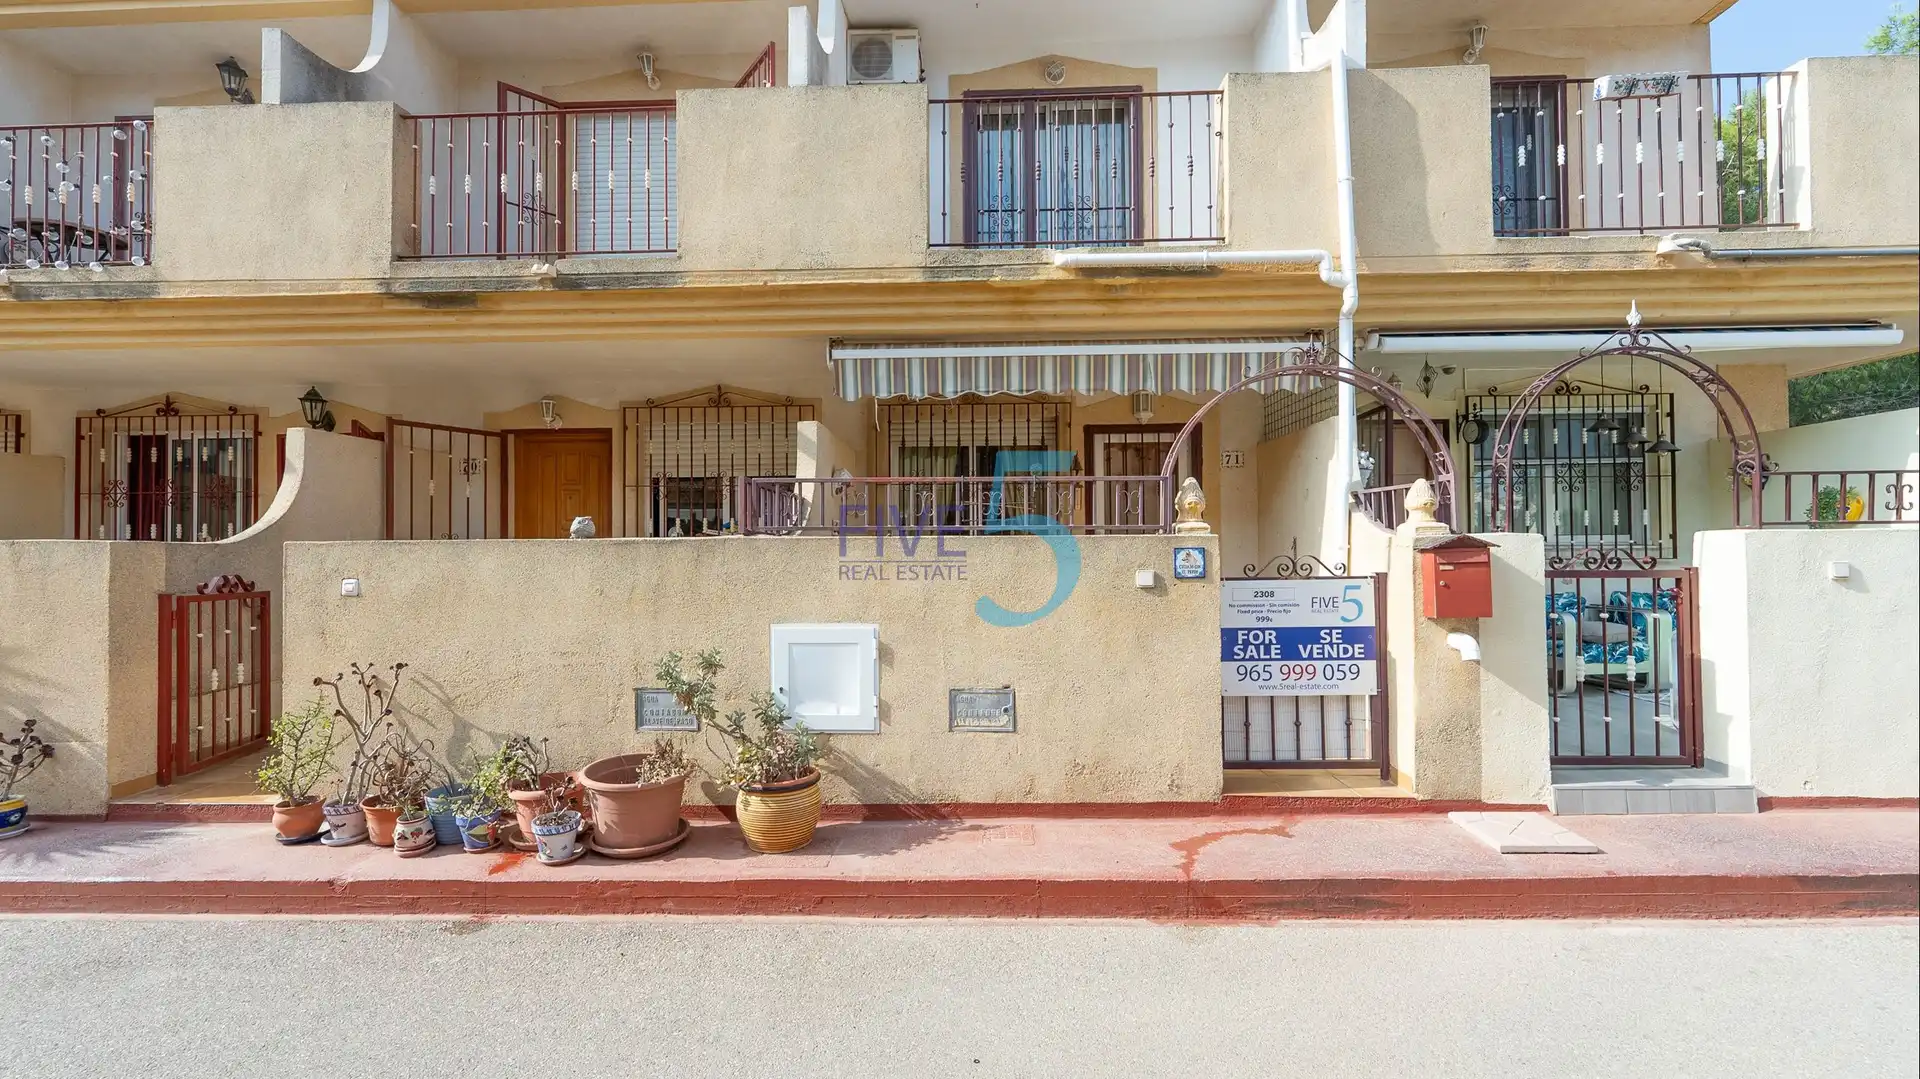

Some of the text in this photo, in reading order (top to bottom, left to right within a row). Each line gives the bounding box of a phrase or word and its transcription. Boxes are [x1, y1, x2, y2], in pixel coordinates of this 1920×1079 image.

[1225, 454, 1240, 465] 71
[1253, 590, 1275, 598] 2308
[1311, 585, 1364, 623] FIVE 5
[1237, 630, 1277, 644] FOR
[1319, 629, 1343, 644] SE
[1233, 645, 1282, 659] SALE
[1298, 644, 1365, 658] VENDE
[1236, 663, 1360, 682] 965 999 059
[1258, 682, 1340, 691] www.5real-estate.com
